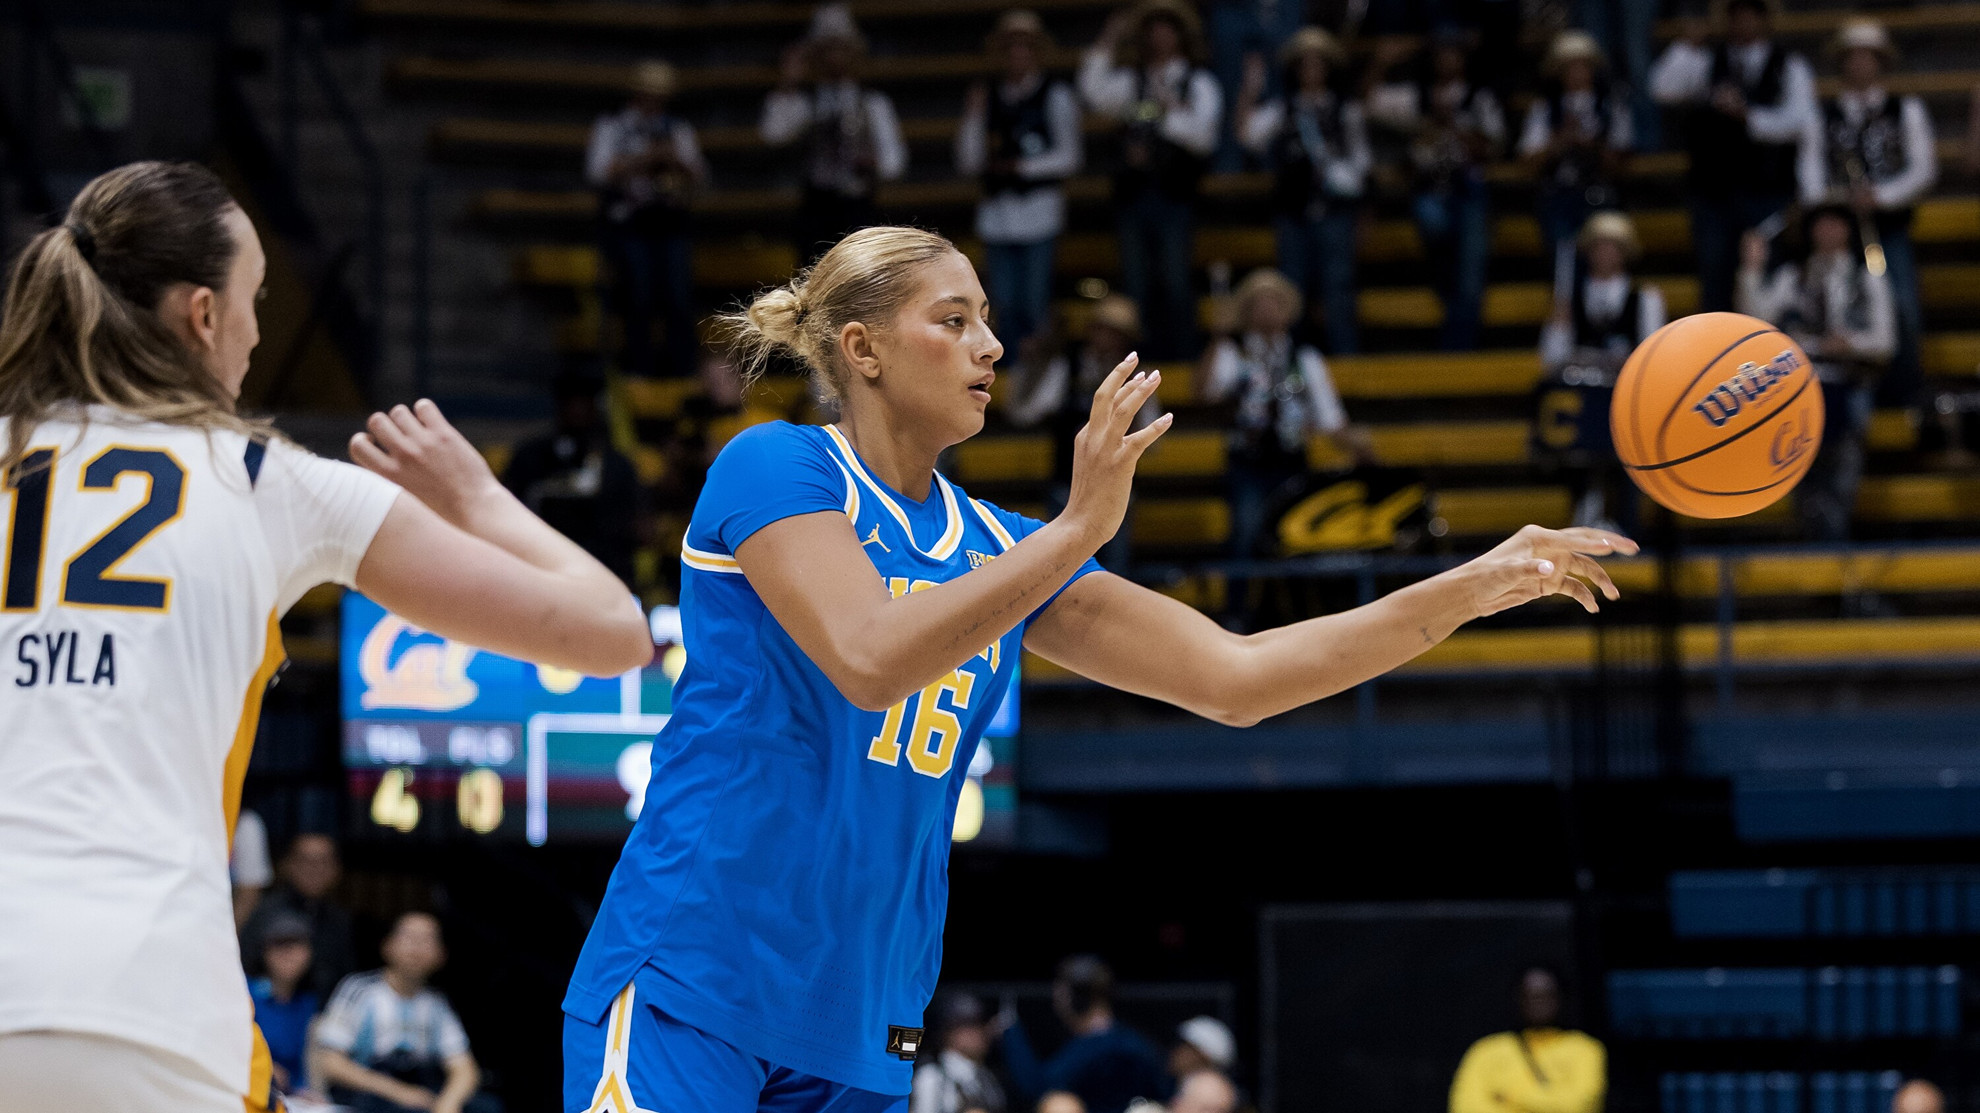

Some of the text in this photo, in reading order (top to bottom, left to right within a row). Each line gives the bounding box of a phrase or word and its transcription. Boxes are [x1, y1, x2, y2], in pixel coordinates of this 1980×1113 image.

[1693, 348, 1801, 427] Wilson
[0, 444, 190, 615] 12
[15, 631, 116, 687] SYLA
[867, 667, 976, 779] 16
